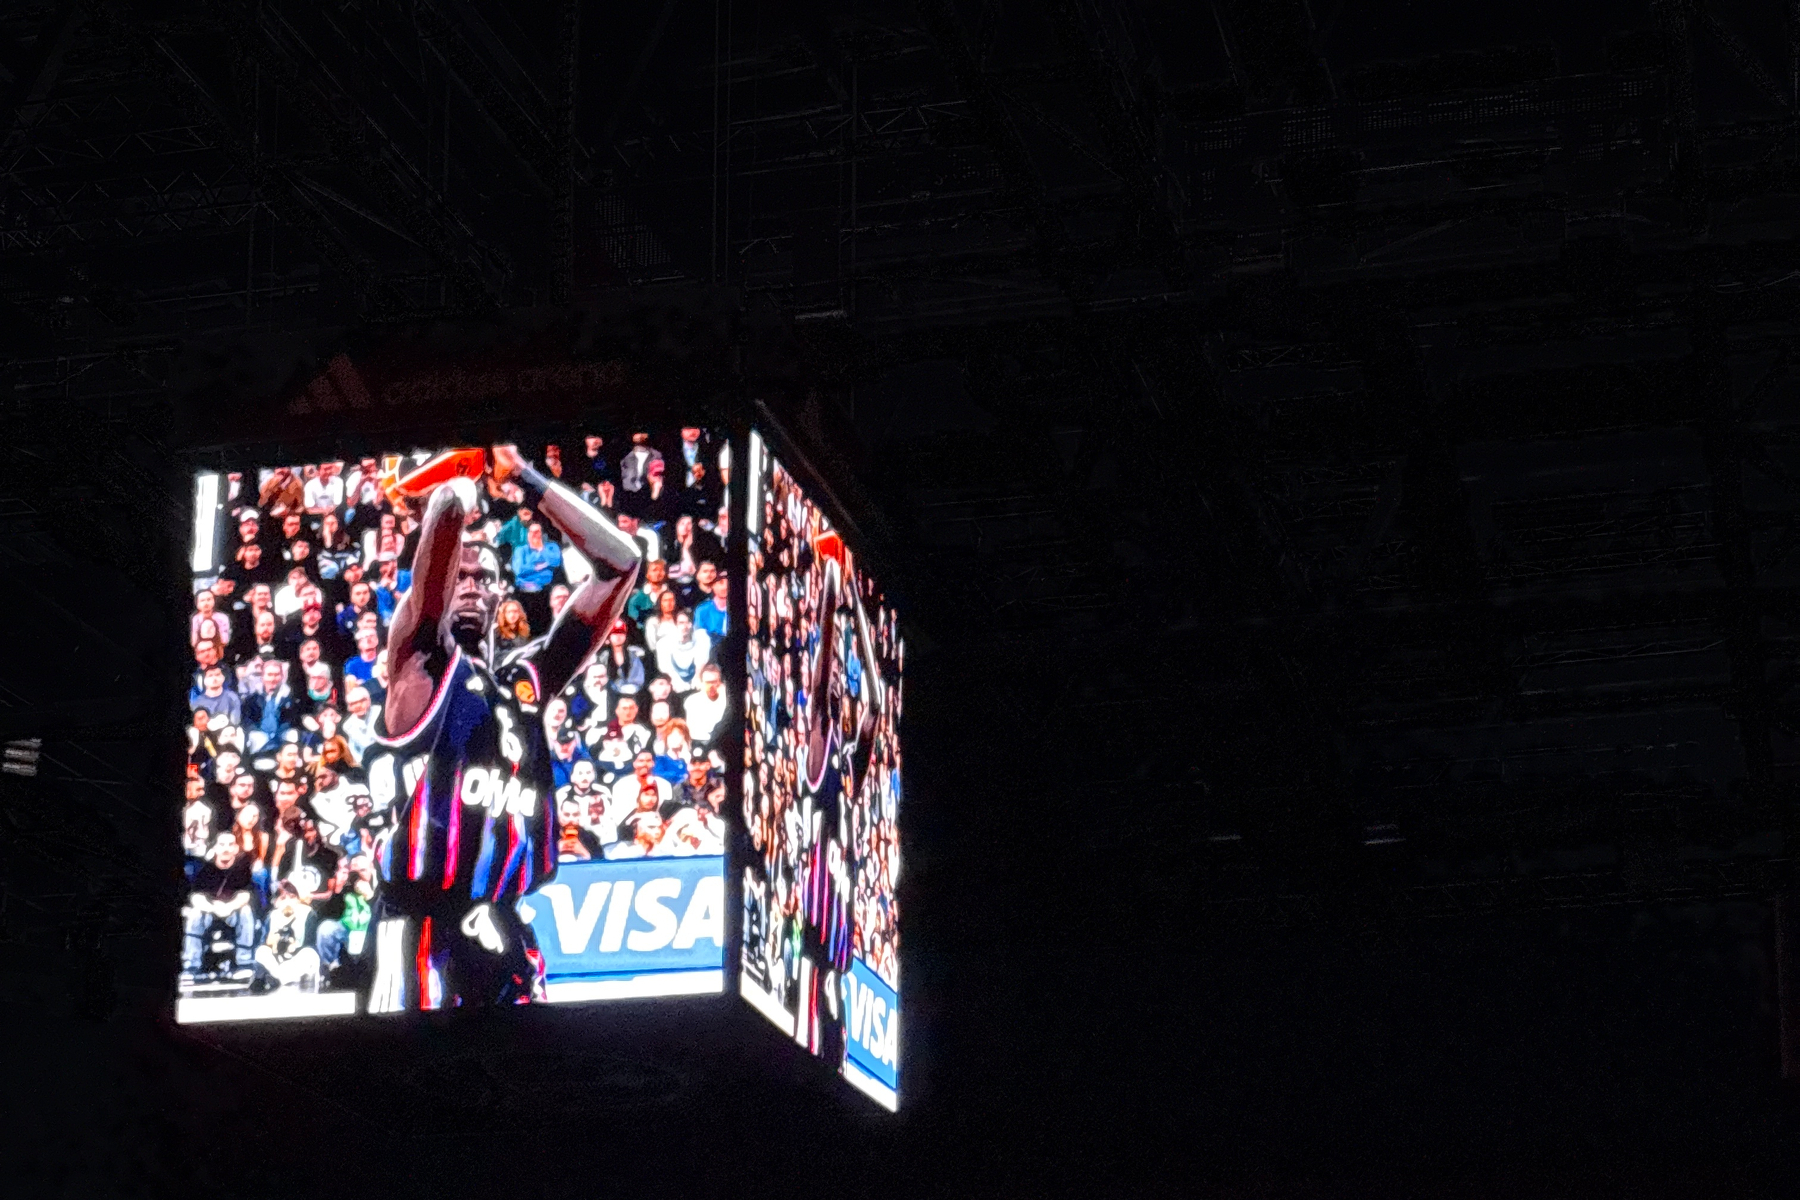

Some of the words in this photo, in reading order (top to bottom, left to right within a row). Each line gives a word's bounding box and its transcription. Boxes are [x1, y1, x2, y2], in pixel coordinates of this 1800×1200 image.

[383, 363, 509, 406] adidas
[517, 360, 627, 394] arena
[539, 876, 725, 955] VISA
[847, 972, 897, 1070] VISA
